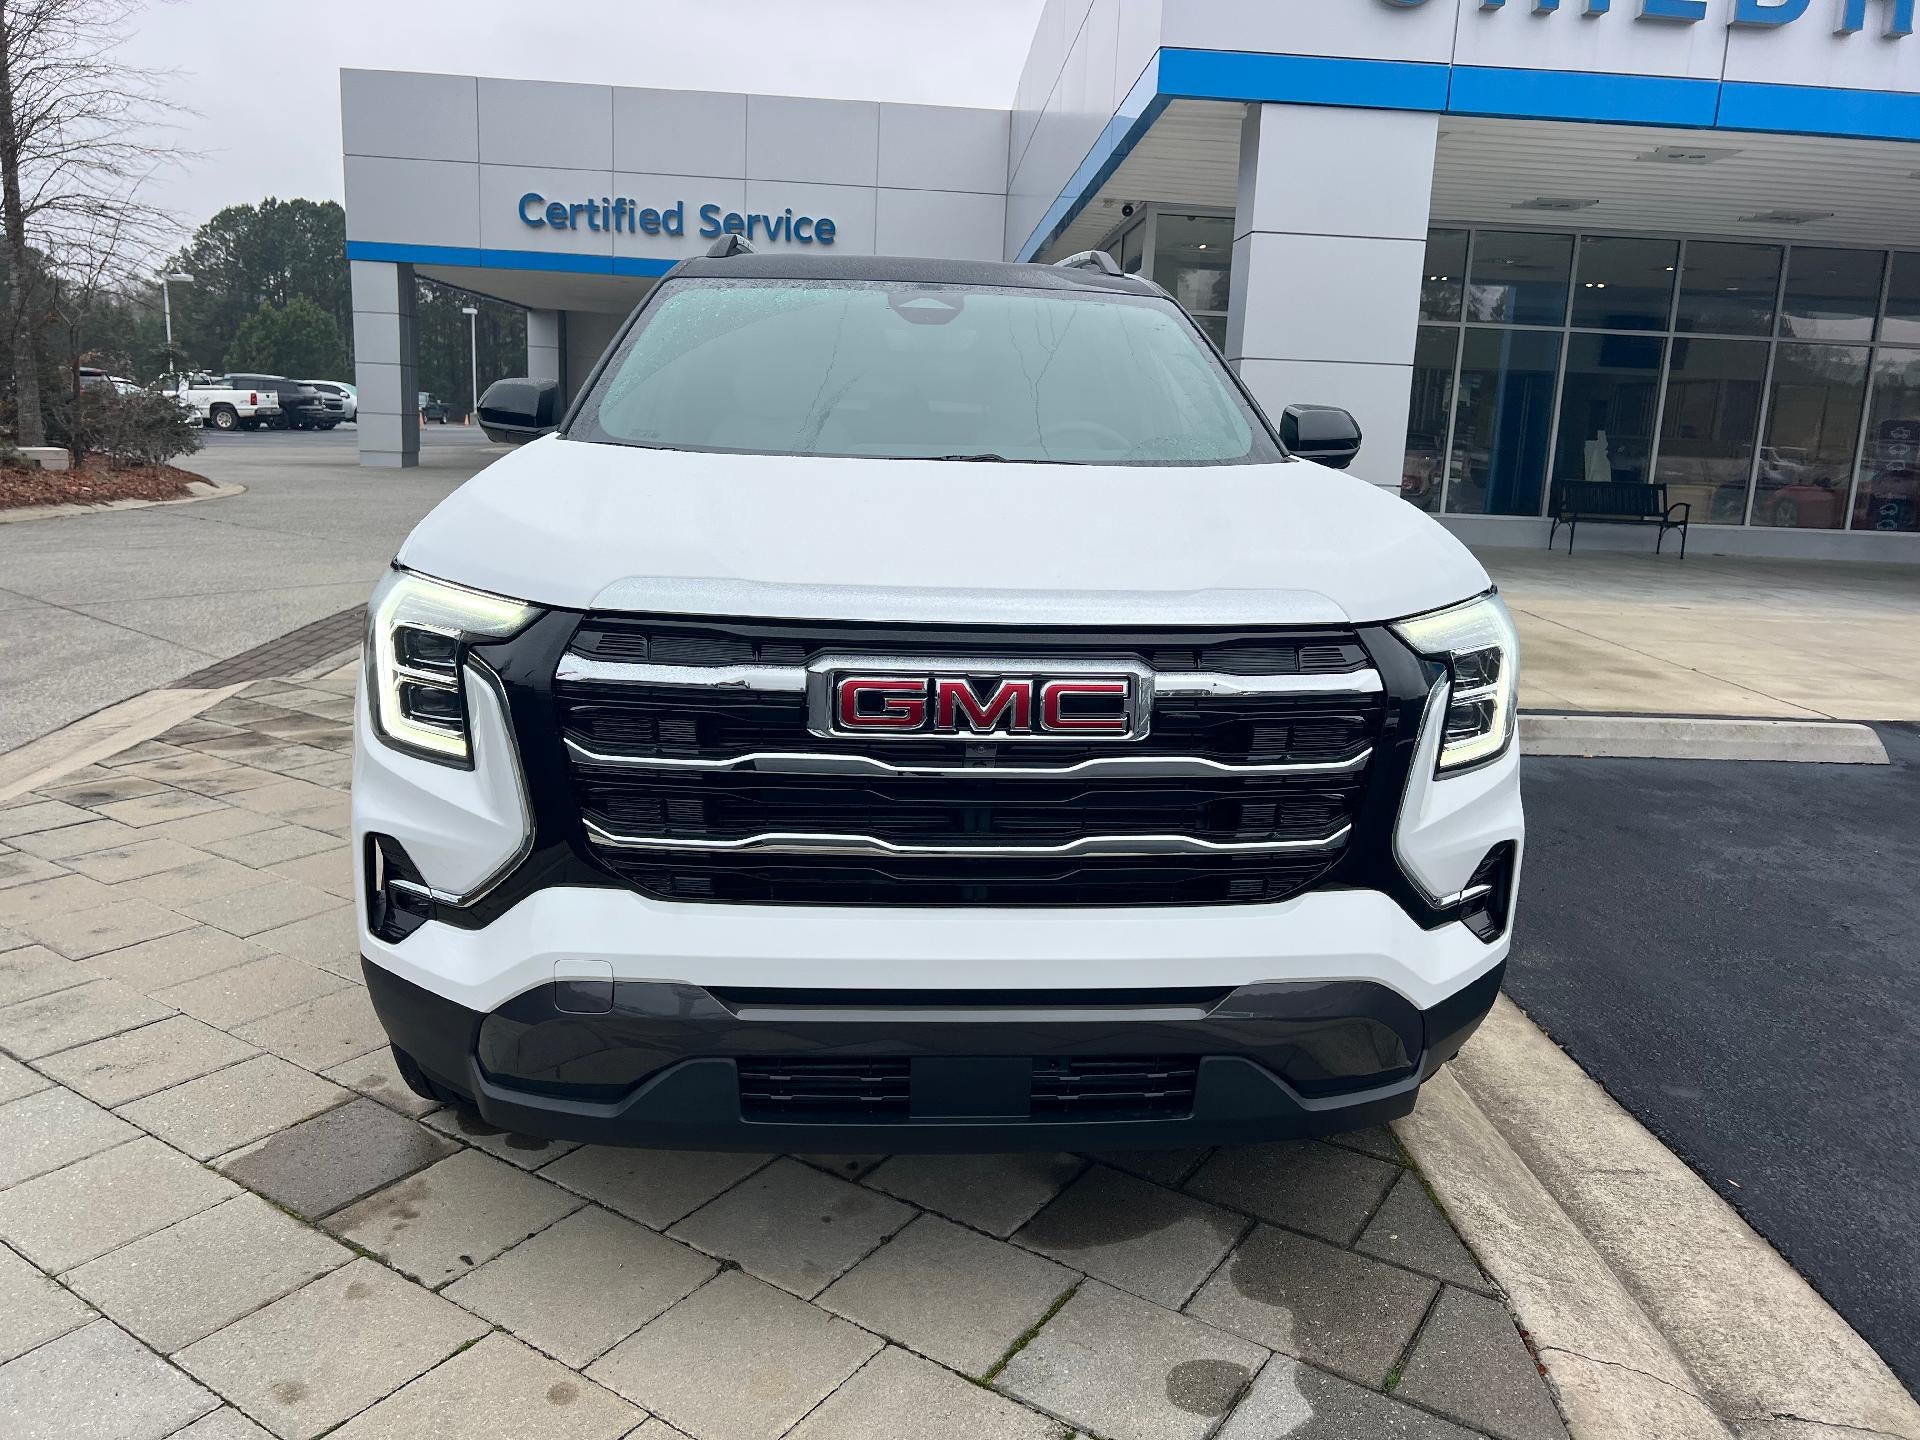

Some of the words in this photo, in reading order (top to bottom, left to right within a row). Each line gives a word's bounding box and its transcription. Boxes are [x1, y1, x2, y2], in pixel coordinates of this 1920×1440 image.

[518, 192, 684, 236] Certified
[699, 203, 837, 244] Service
[838, 676, 1130, 735] GMC
